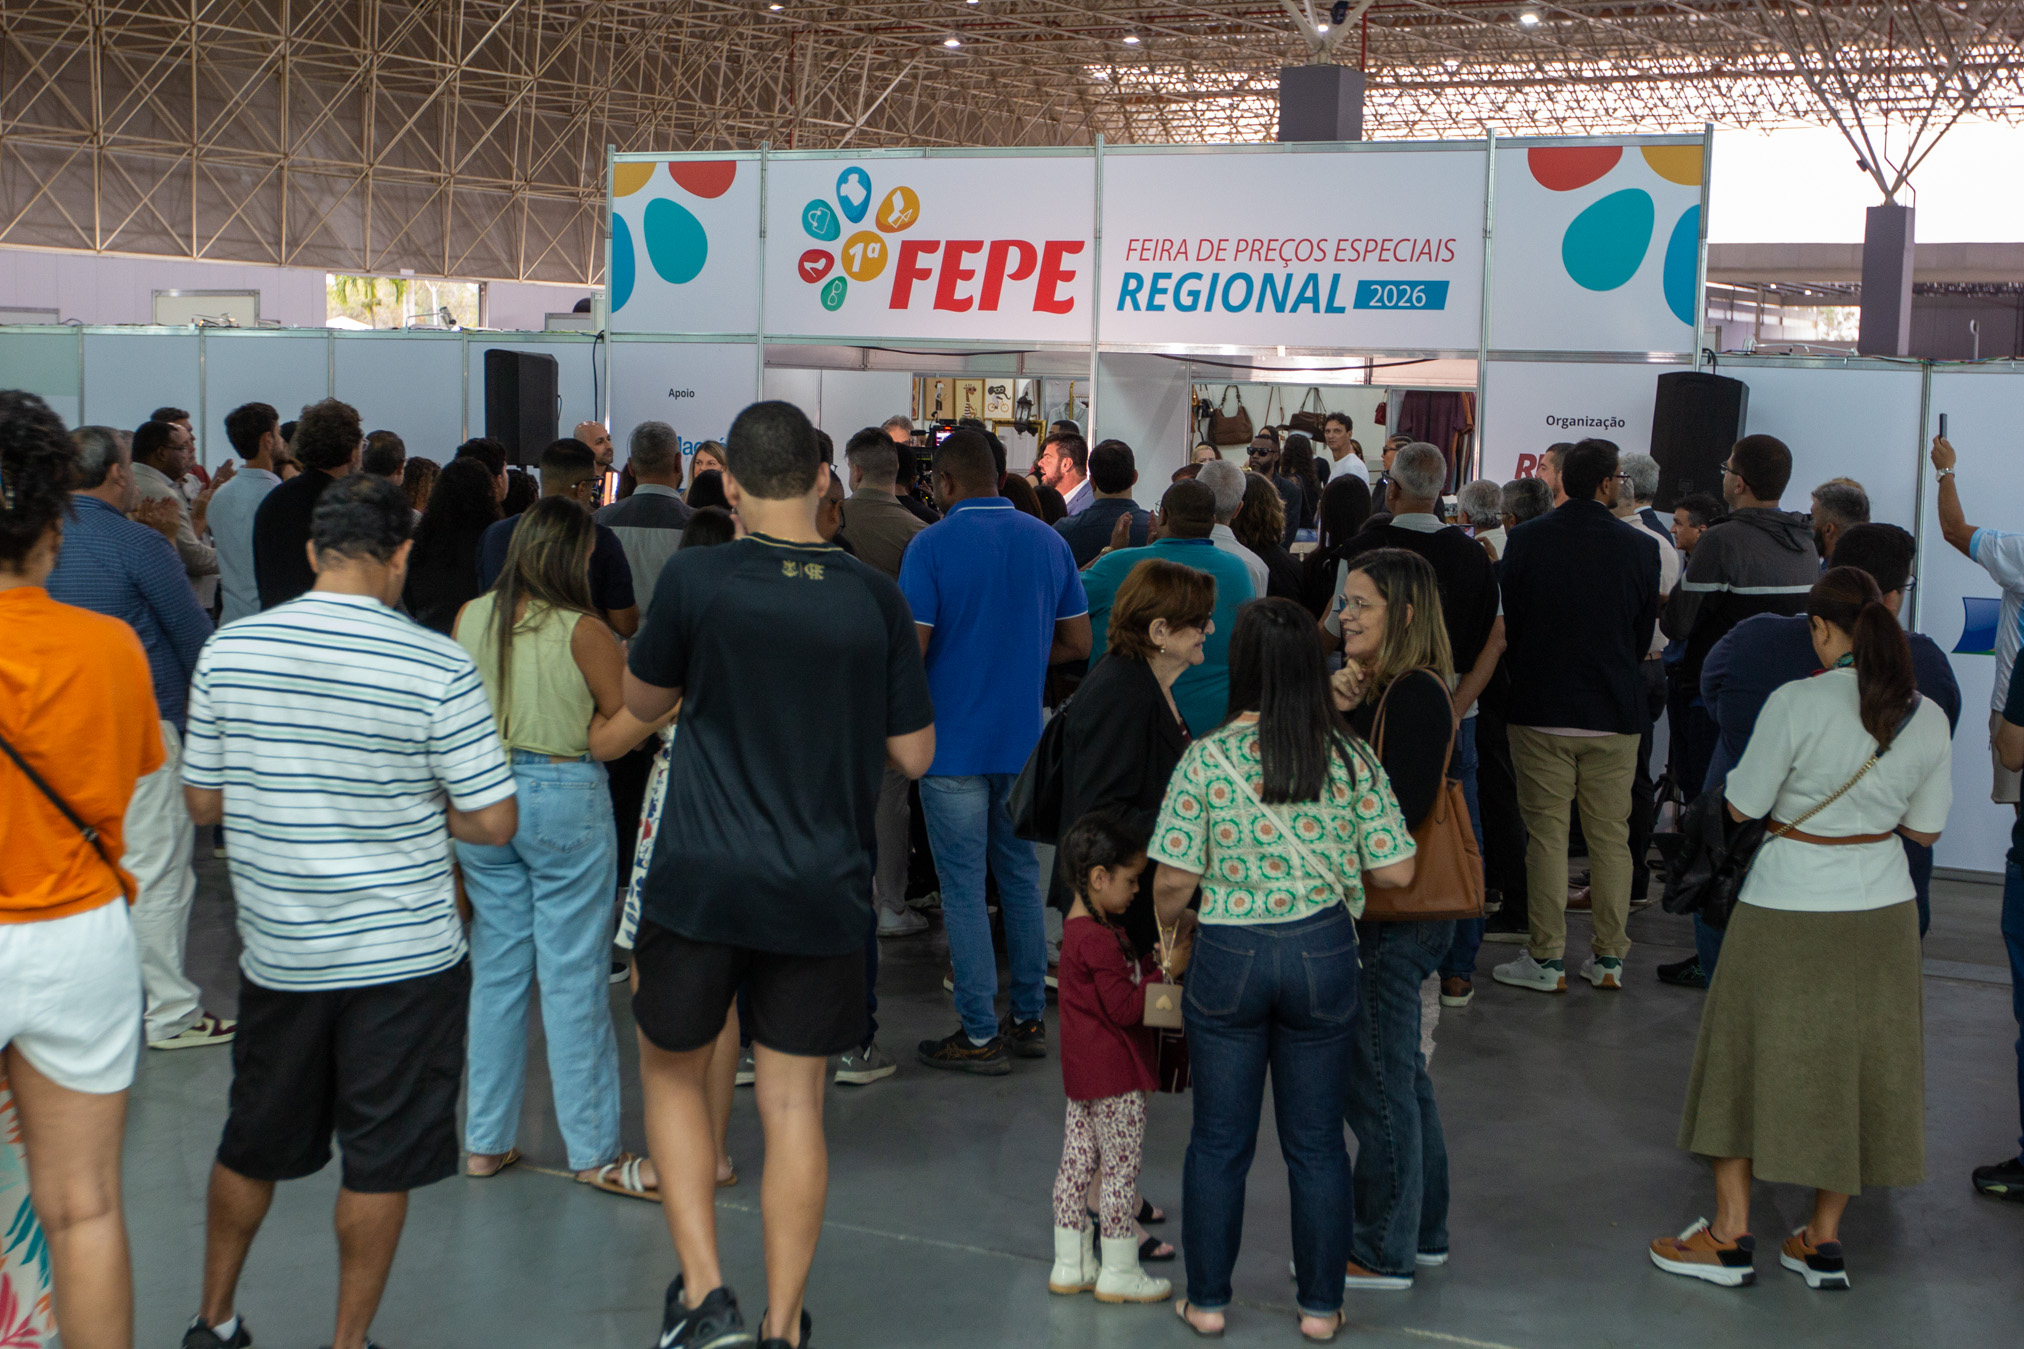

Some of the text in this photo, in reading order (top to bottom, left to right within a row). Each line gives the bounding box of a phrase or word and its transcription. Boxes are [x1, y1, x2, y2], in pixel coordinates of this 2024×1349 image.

[1125, 238, 1457, 269] FEIRA DE PREÇOS ESPECIAIS
[888, 239, 1086, 315] FEPE
[1116, 271, 1427, 315] REGIONAL 2026
[668, 388, 695, 400] Apoio
[1545, 415, 1626, 430] Organização
